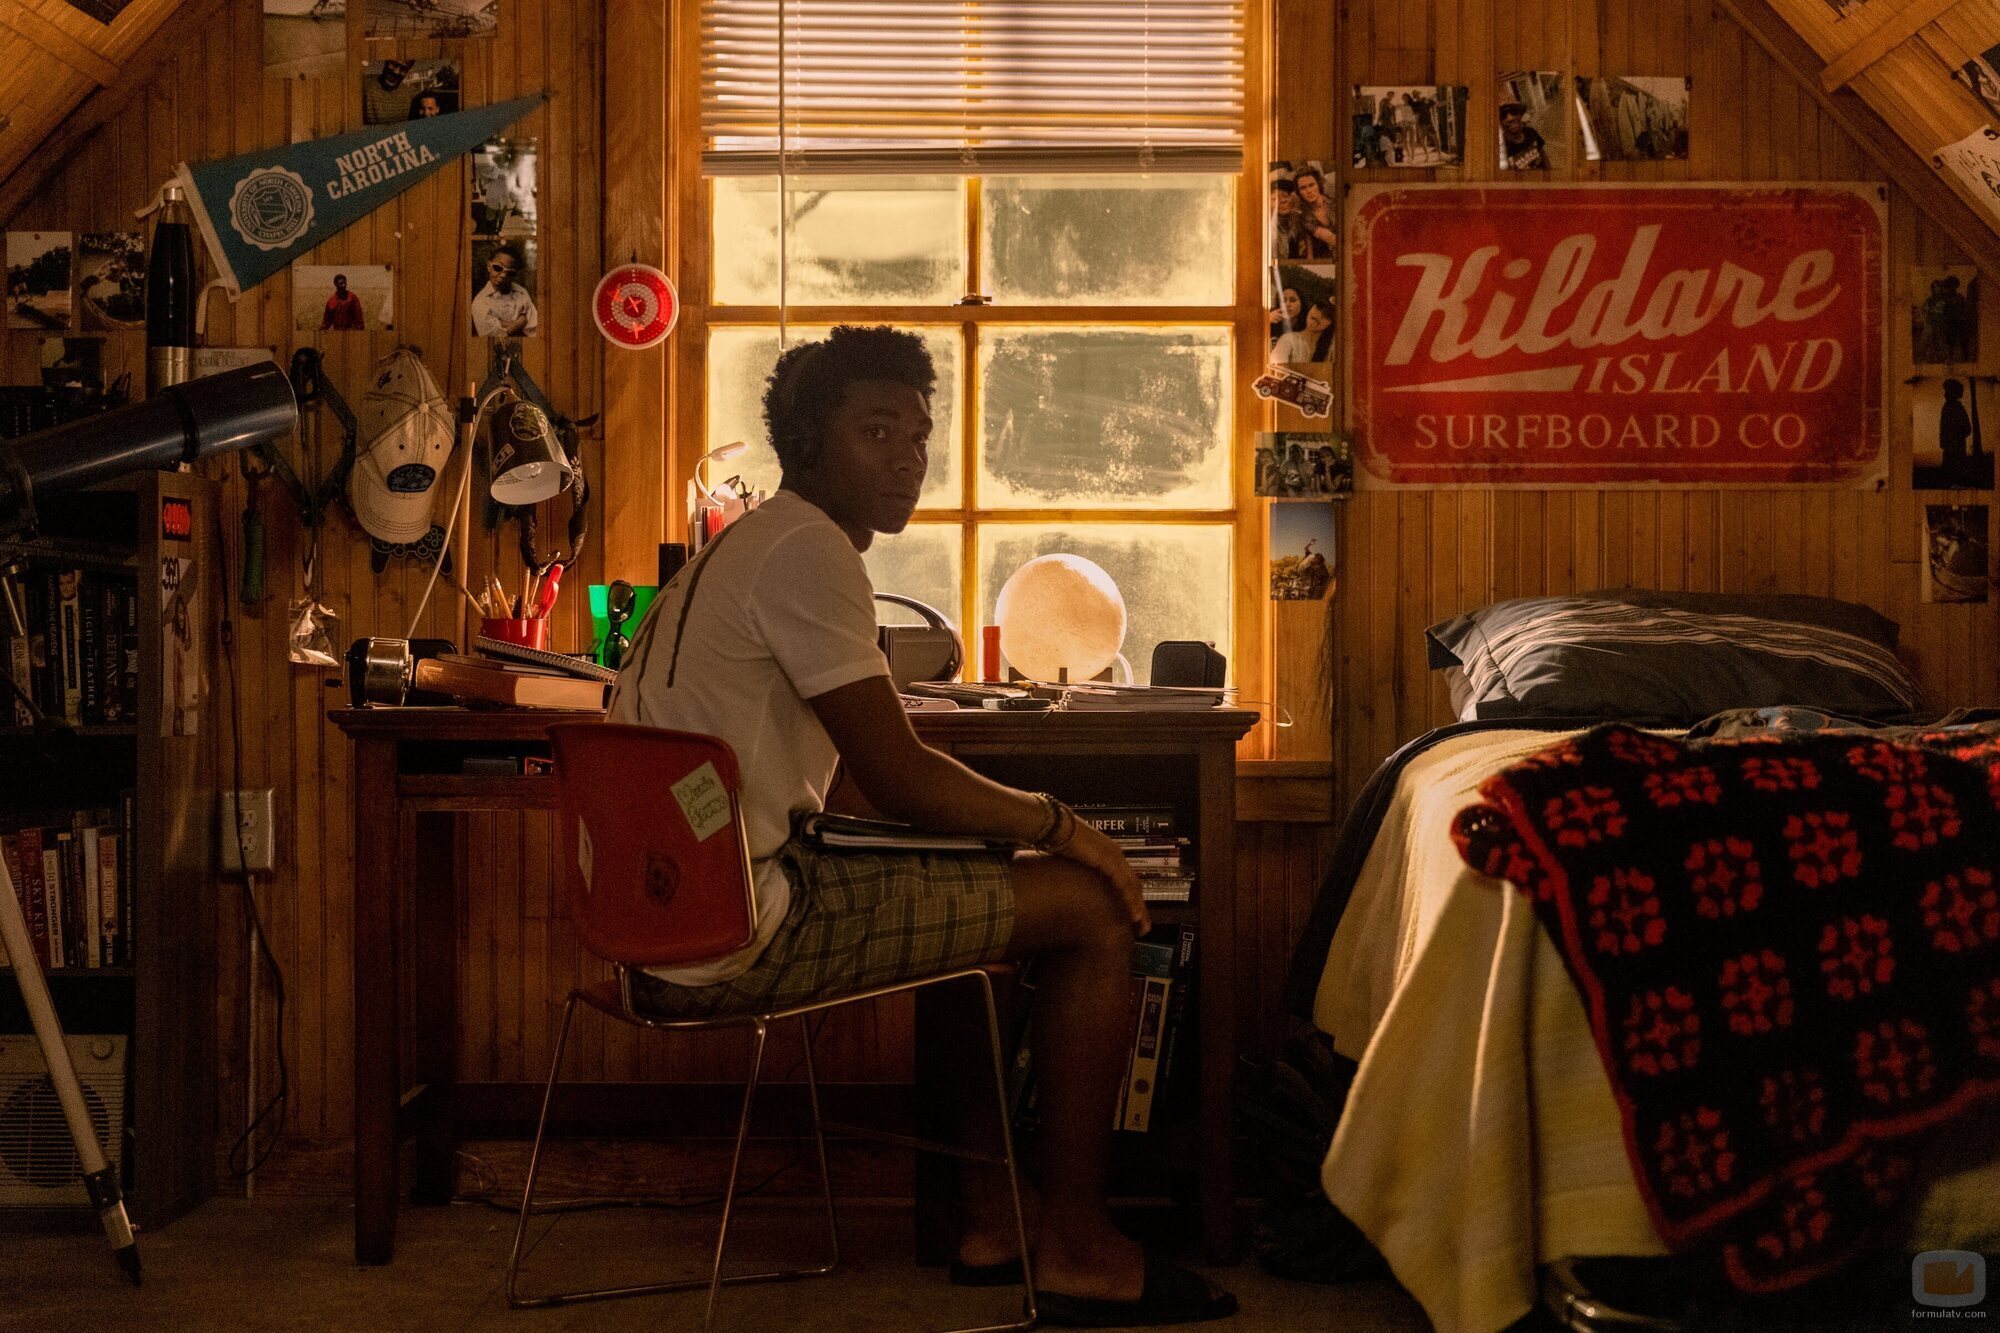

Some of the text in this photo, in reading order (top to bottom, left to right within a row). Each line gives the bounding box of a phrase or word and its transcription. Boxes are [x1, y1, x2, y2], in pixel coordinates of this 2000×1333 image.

[326, 144, 436, 200] CAROLINA
[335, 131, 412, 176] NORTH
[1383, 223, 1842, 366] Kildare
[1584, 337, 1844, 394] ISLAND
[1414, 412, 1808, 450] SURFBOARD CO
[84, 608, 94, 644] LIGHT
[86, 657, 95, 707] FEATHER
[106, 633, 118, 687] DEFIANT
[32, 878, 42, 905] SKY
[49, 883, 58, 936] STRONGER
[34, 912, 44, 940] KEY
